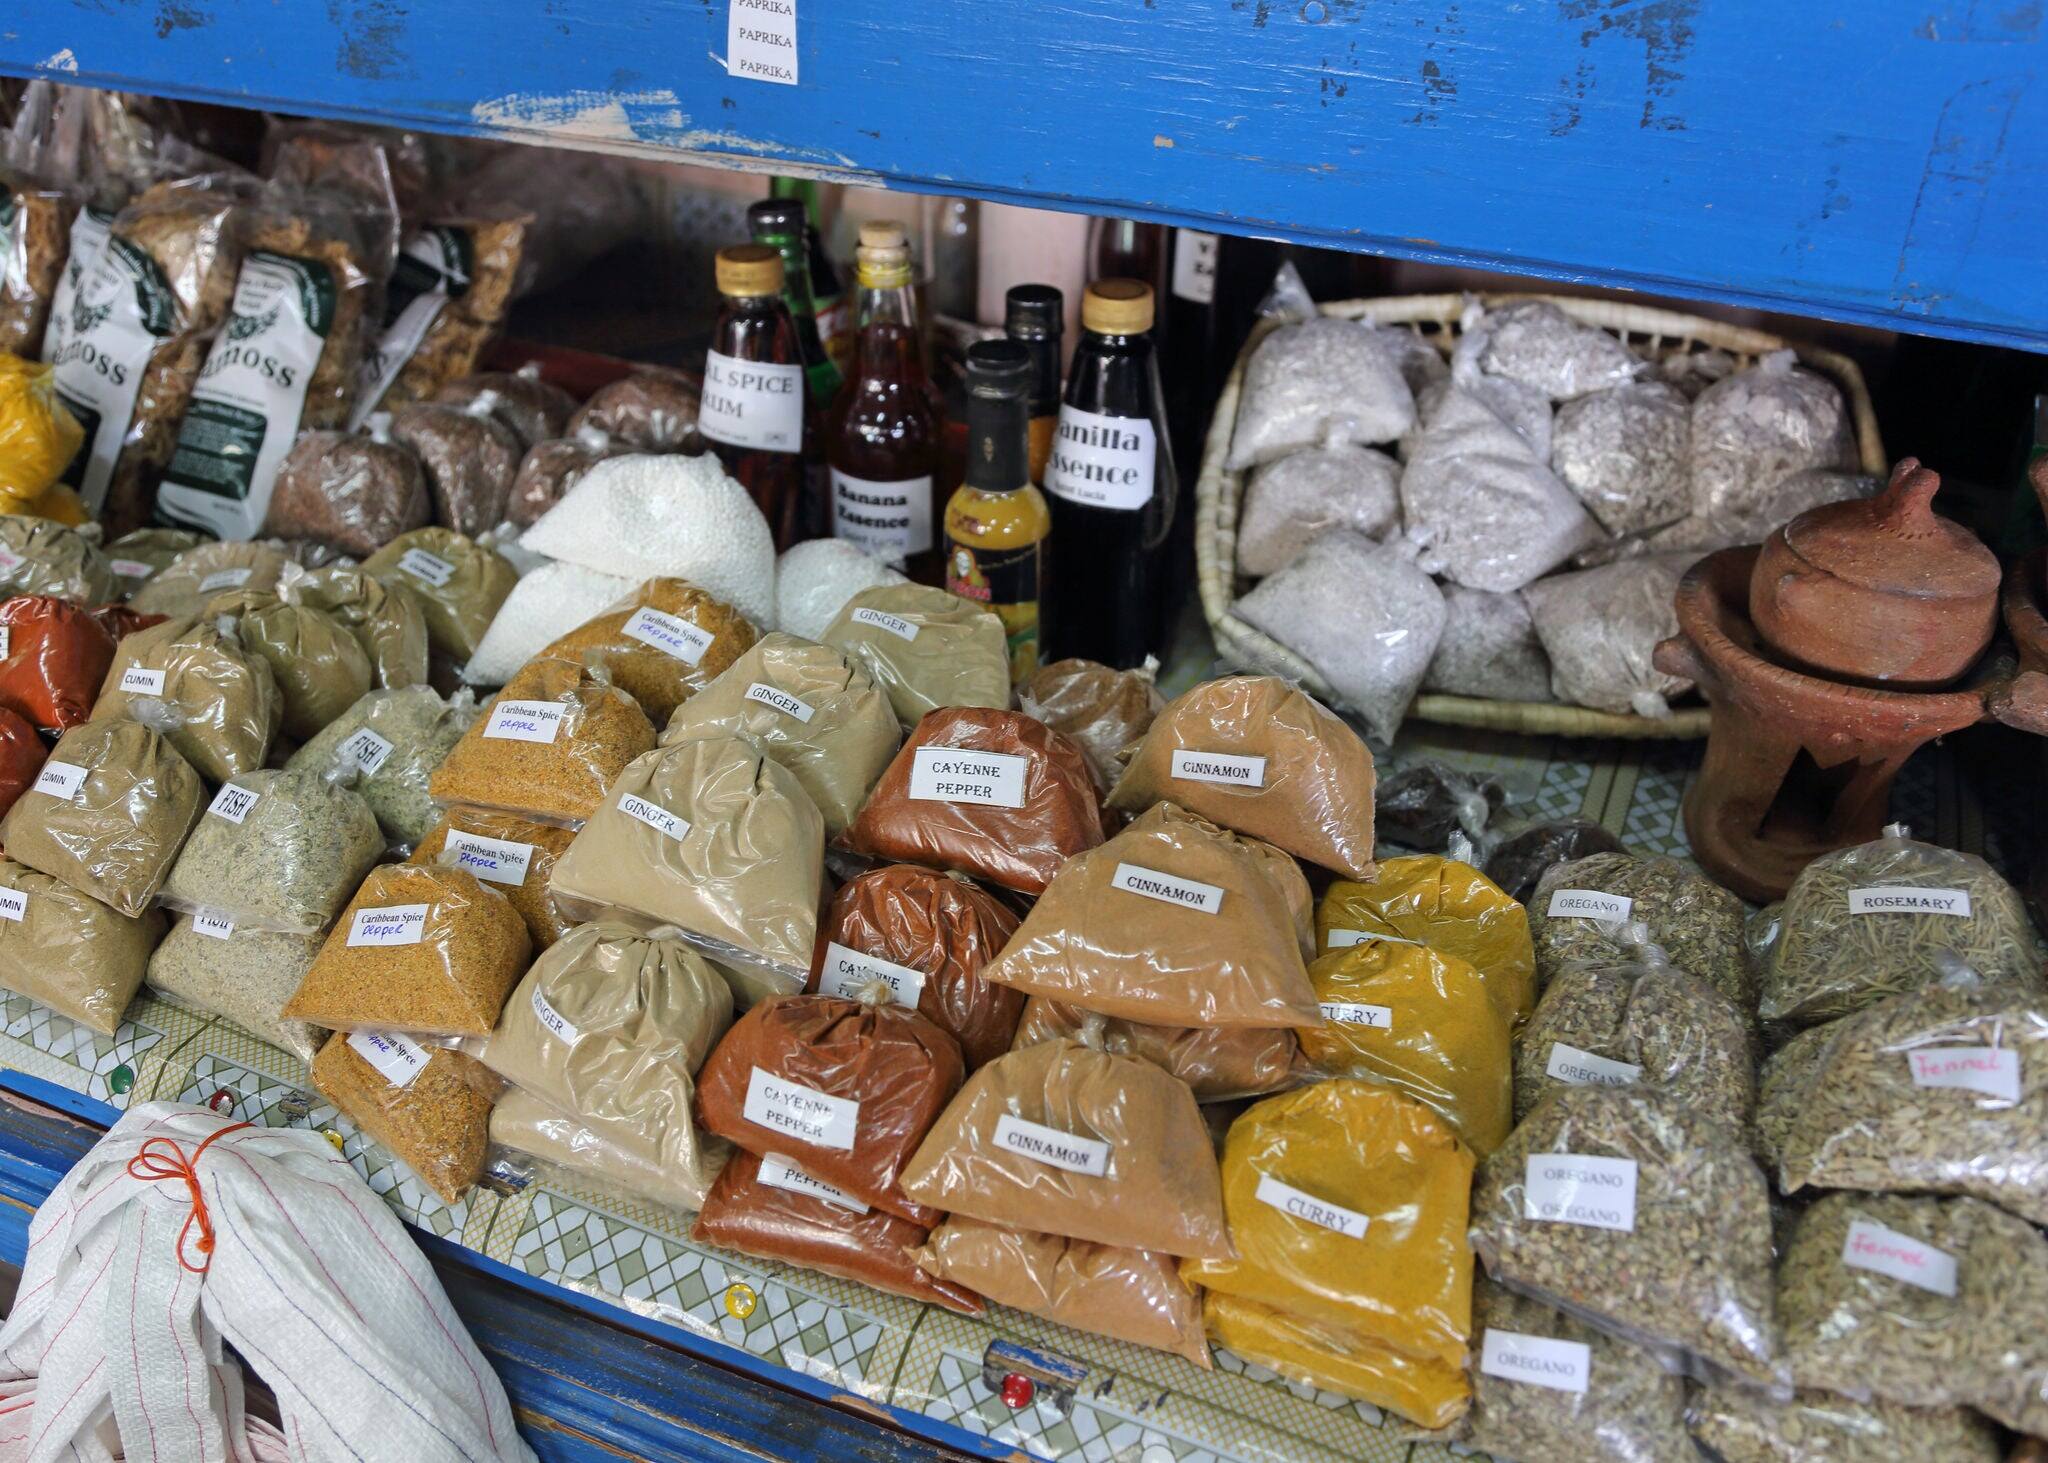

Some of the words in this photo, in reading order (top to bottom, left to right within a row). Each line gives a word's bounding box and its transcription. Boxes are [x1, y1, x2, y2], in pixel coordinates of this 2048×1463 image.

[739, 27, 793, 48] PAPRIKA
[740, 59, 793, 80] PAPRIKA
[728, 370, 793, 394] SPICE
[838, 483, 907, 506] Banana
[642, 613, 680, 633] Caribbean
[681, 629, 704, 648] Spice
[860, 609, 907, 633] GINGER
[125, 674, 155, 687] CUMIN
[501, 705, 537, 717] Caribbean
[537, 708, 559, 721] Spice
[752, 687, 800, 715] GINGER
[349, 736, 383, 764] FISH
[41, 772, 67, 785] CUMIN
[932, 762, 1001, 778] CAYENNE
[936, 782, 992, 799] PEPPER
[217, 789, 251, 818] FISH
[625, 799, 675, 832] GINGER
[455, 839, 497, 858] Caribbean
[498, 850, 525, 865] Spice
[1127, 876, 1206, 905] CINNAMON
[1559, 898, 1619, 912] OREGANO
[1863, 896, 1955, 910] ROSEMARY
[361, 914, 400, 924] Caribbean
[401, 912, 424, 924] Spice
[764, 1086, 833, 1117] CAYENNE
[766, 1109, 823, 1138] PEPPER
[1008, 1132, 1090, 1167] CINNAMON
[1543, 1168, 1624, 1189] OREGANO
[1286, 1196, 1353, 1232] CURRY
[1497, 1350, 1577, 1378] OREGANO
